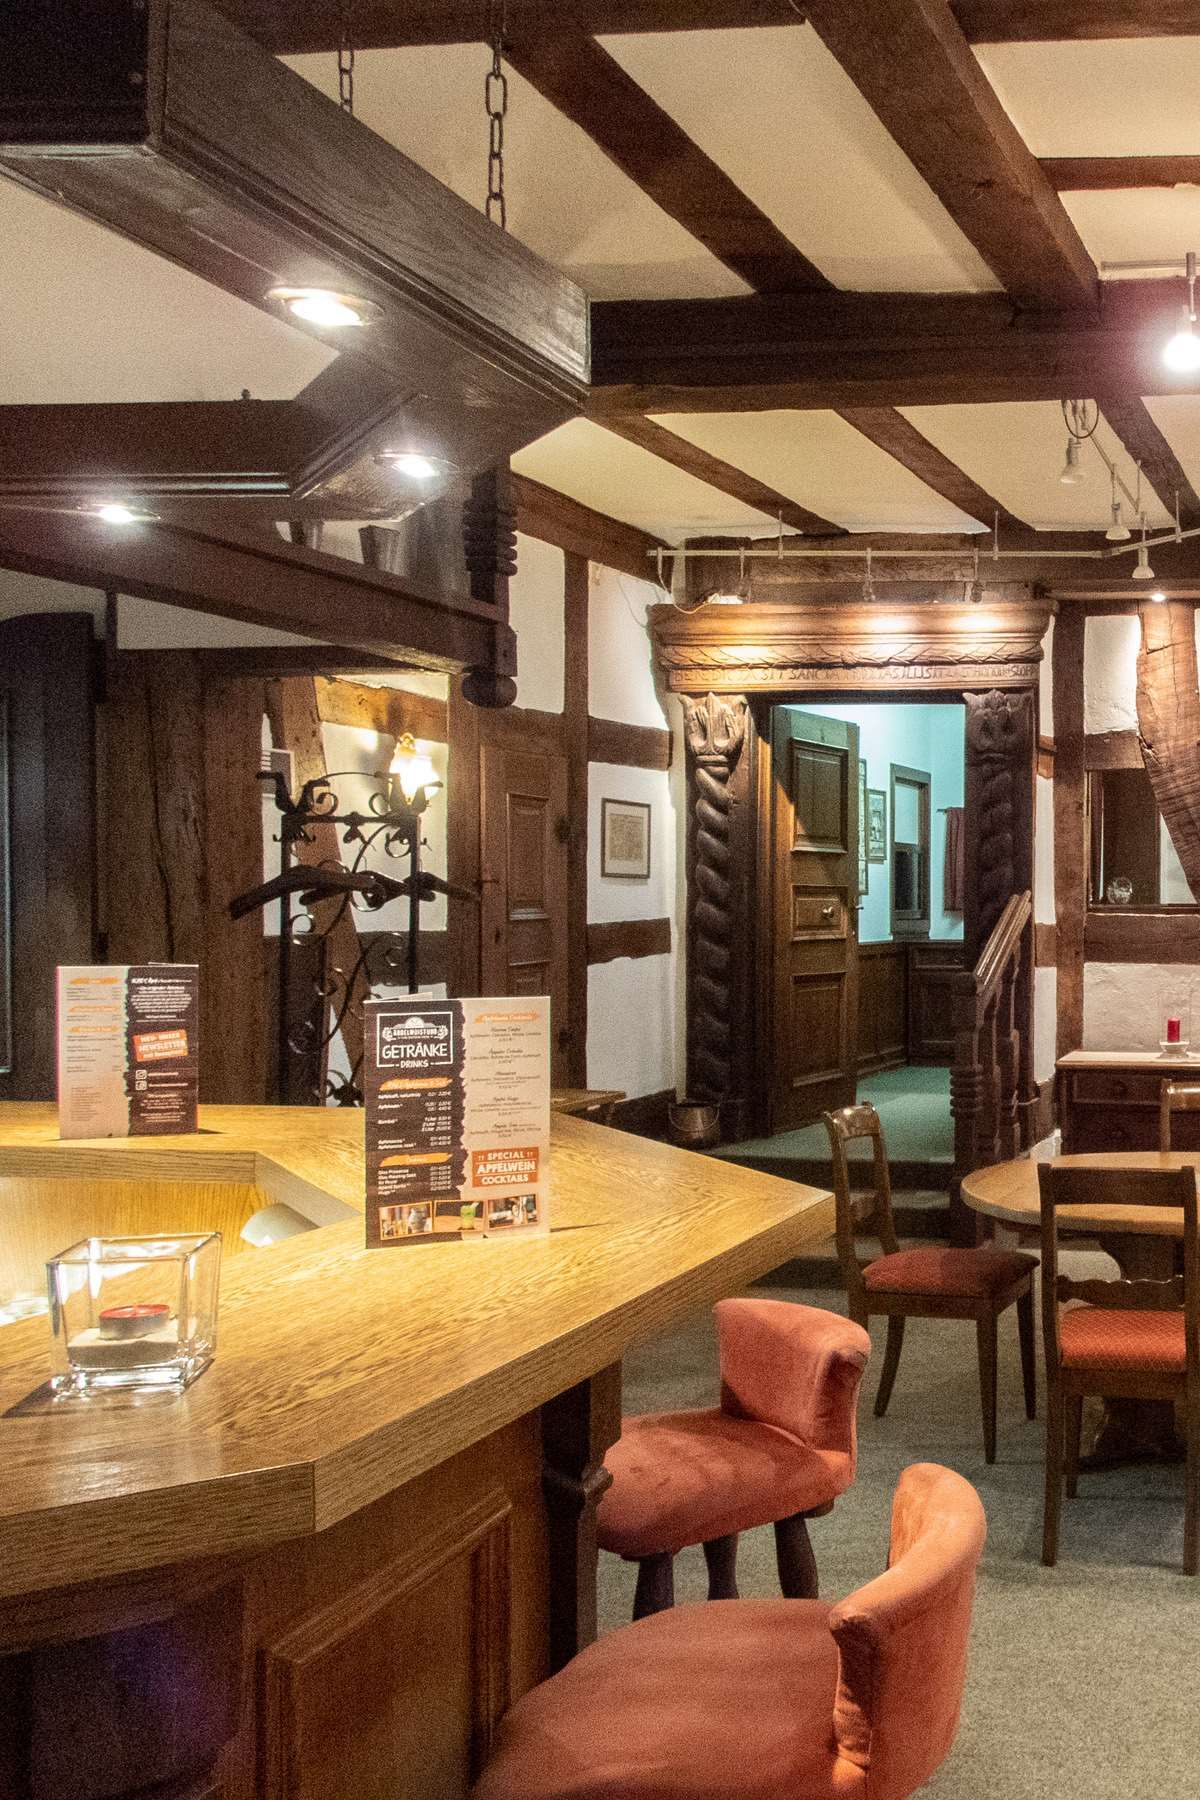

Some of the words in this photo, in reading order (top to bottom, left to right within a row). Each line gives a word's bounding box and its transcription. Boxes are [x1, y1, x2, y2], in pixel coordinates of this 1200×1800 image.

[382, 1042, 448, 1059] GETRÄNKE
[400, 1060, 429, 1068] DRINKS
[487, 1151, 525, 1160] SPECIAL
[477, 1161, 536, 1174] APFELWEIN
[481, 1174, 529, 1185] COCKTAILS
